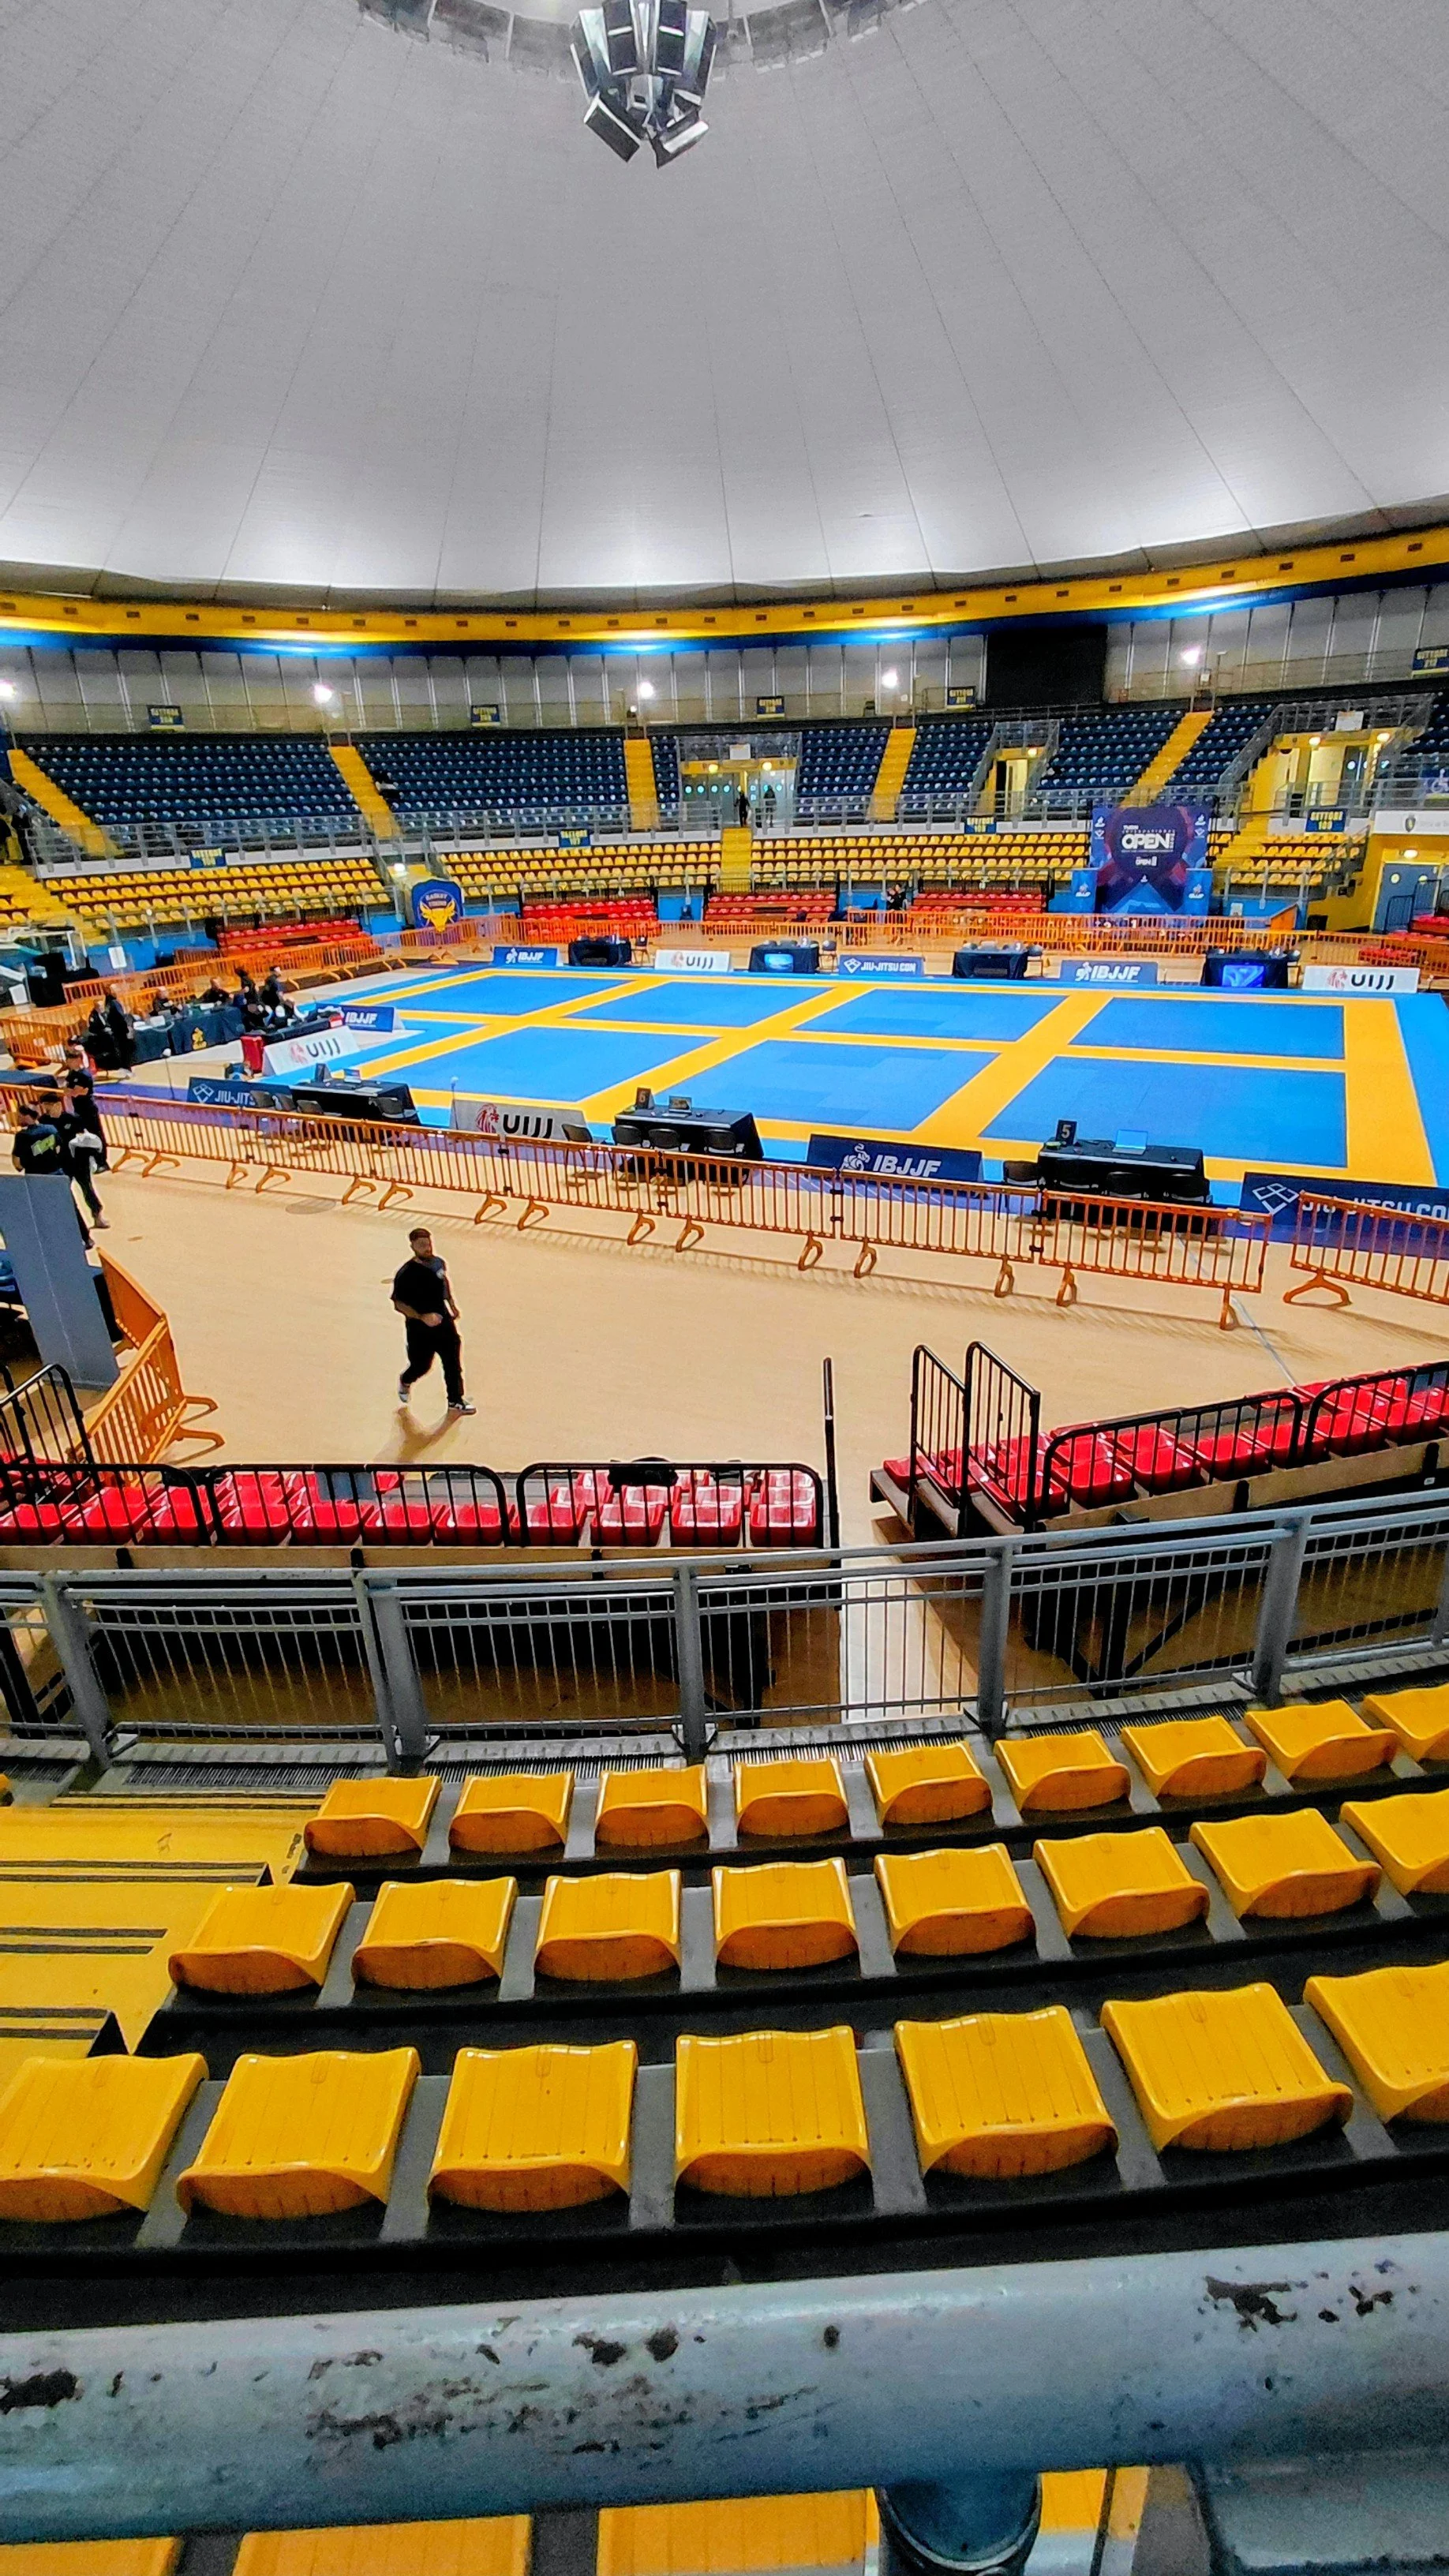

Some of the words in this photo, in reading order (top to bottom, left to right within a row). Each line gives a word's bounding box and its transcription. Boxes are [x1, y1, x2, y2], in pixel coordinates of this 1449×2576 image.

[1121, 833, 1170, 850] OPEN
[686, 956, 713, 969] UIJJ
[1091, 965, 1141, 979] IBJJF
[1351, 974, 1395, 990] UIJJ
[345, 1012, 378, 1024] IBJJF
[306, 1038, 341, 1058] UIJJ
[503, 1114, 553, 1139] UIJJ
[1061, 1124, 1072, 1139] 5
[873, 1154, 942, 1178] IBJJF
